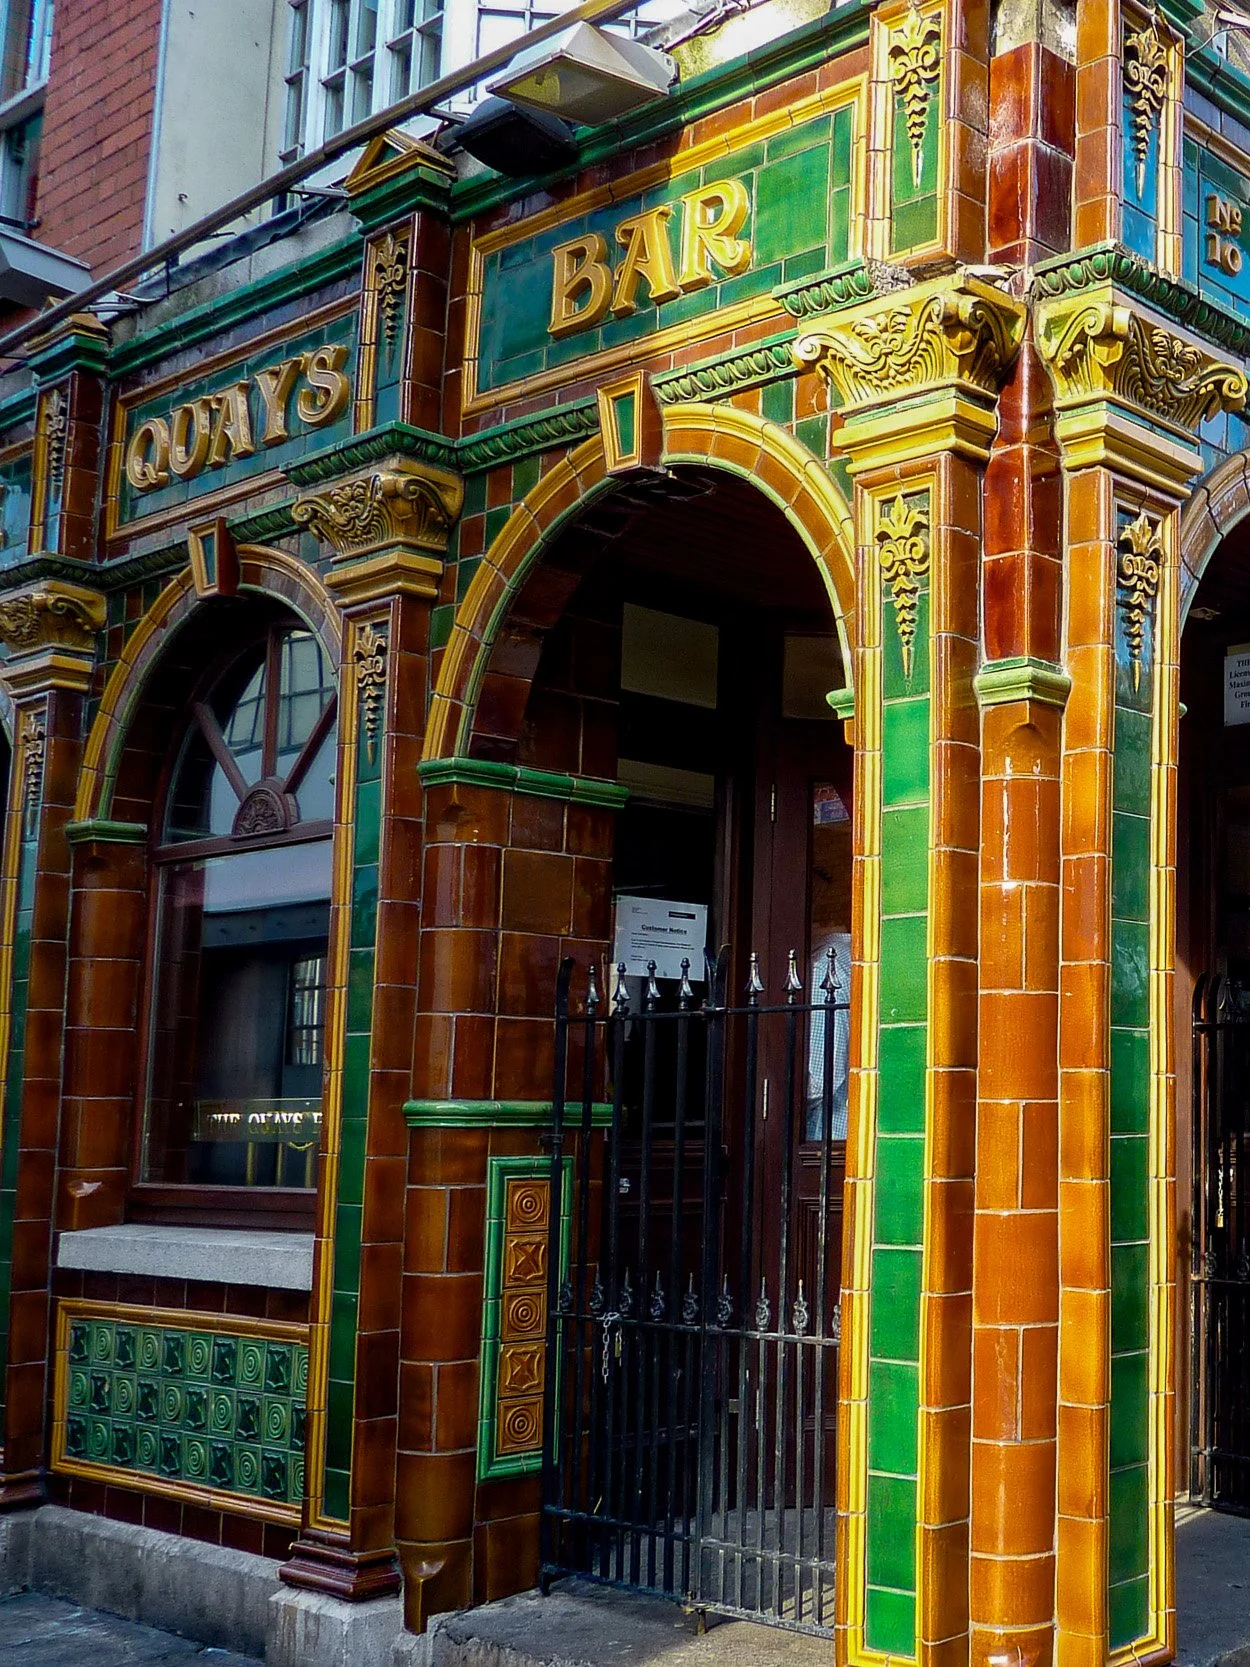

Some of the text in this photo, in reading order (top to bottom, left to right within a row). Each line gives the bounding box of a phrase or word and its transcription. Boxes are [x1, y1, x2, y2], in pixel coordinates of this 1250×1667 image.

[548, 178, 753, 341] BAR
[126, 344, 351, 493] QUAYS
[641, 924, 688, 936] Customer Notice
